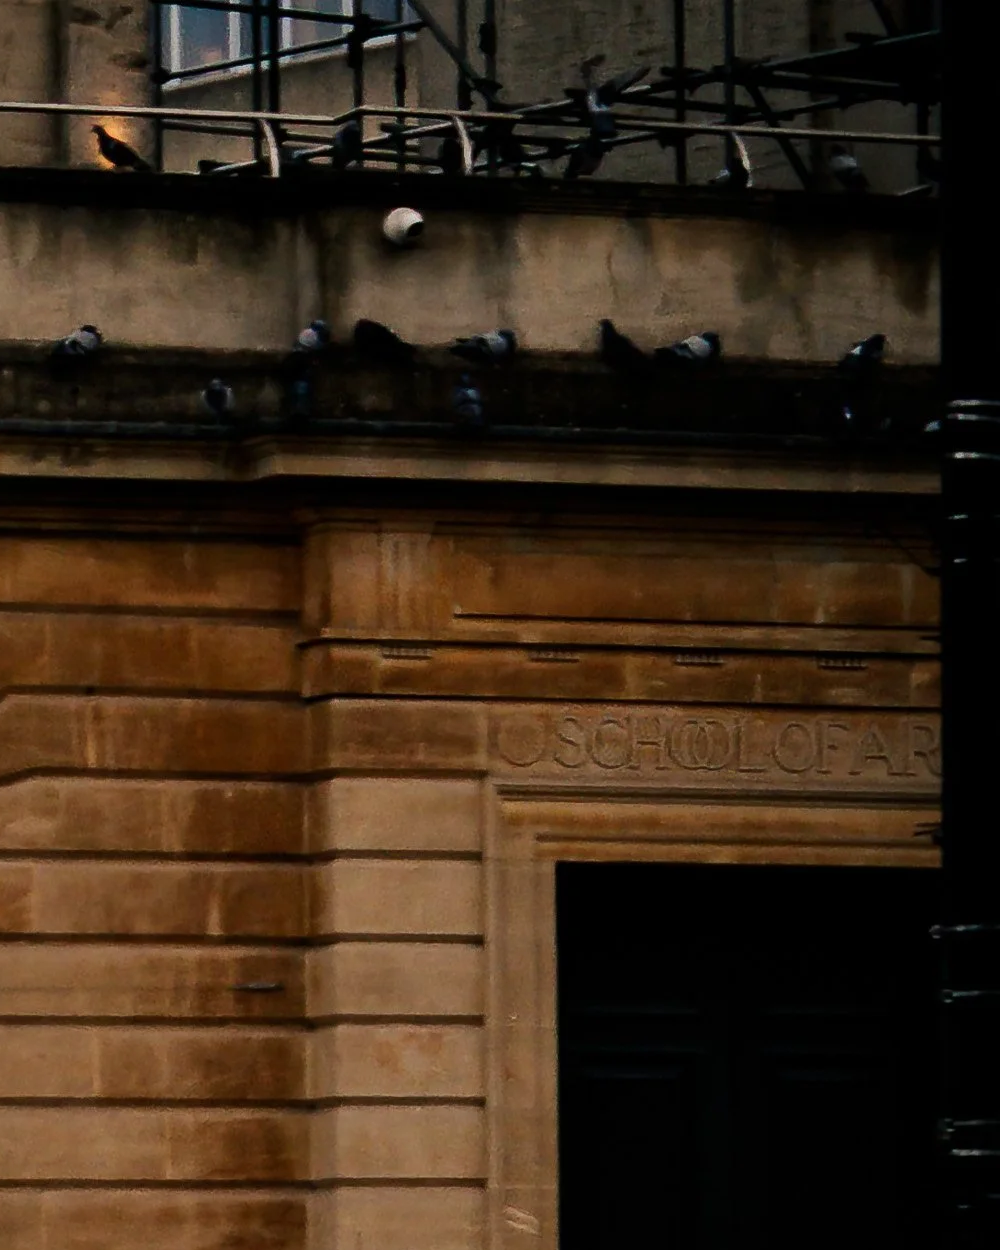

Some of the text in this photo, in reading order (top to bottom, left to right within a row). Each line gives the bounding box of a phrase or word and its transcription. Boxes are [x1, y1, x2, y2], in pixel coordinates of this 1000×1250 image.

[552, 714, 942, 779] SCHOOL OF AR
